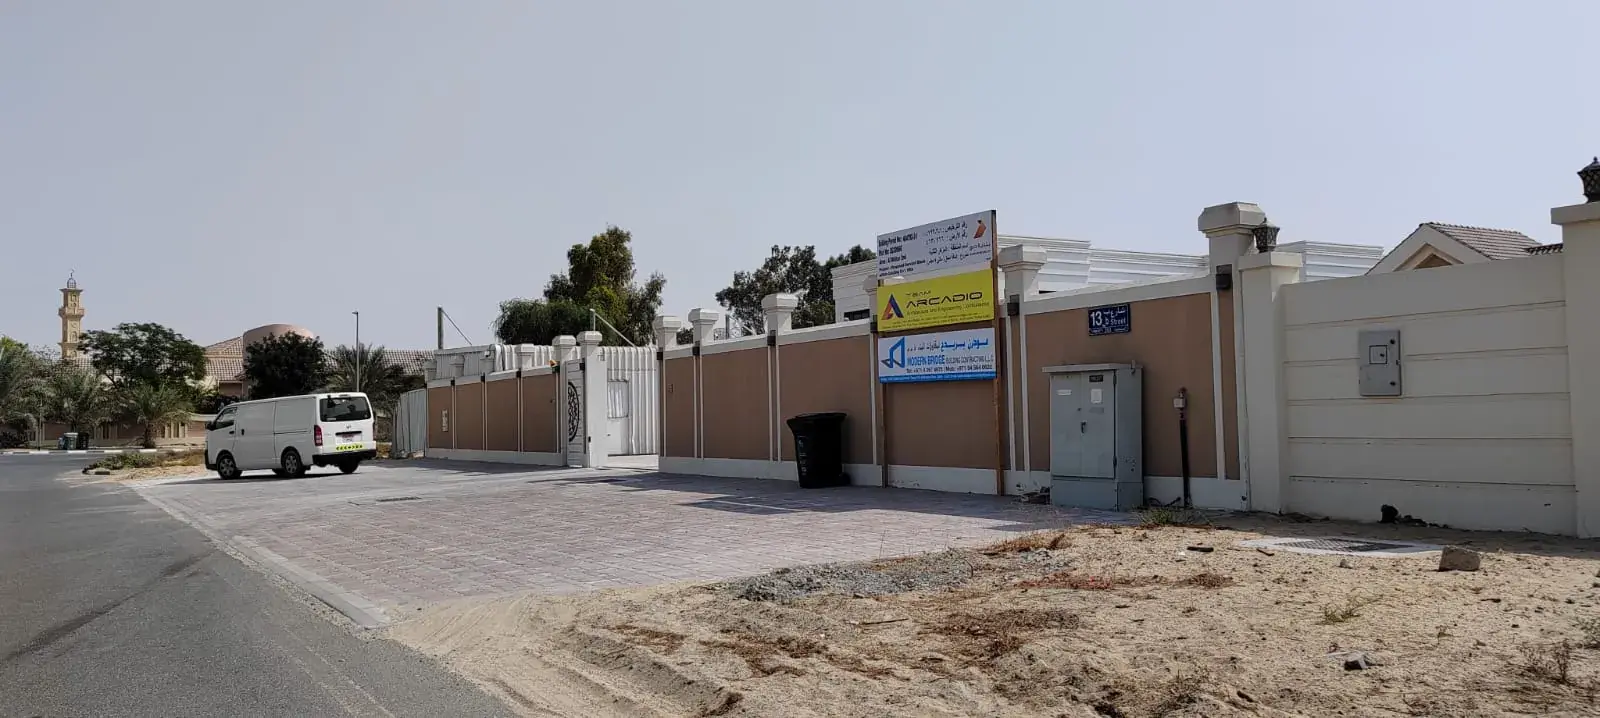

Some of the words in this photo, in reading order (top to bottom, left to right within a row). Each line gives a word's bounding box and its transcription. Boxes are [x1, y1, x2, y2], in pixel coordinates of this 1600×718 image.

[906, 291, 983, 308] ARCADIO
[1090, 311, 1102, 326] 13
[1110, 317, 1126, 326] Street
[907, 355, 927, 366] MODERN
[928, 354, 945, 365] BRIDGE
